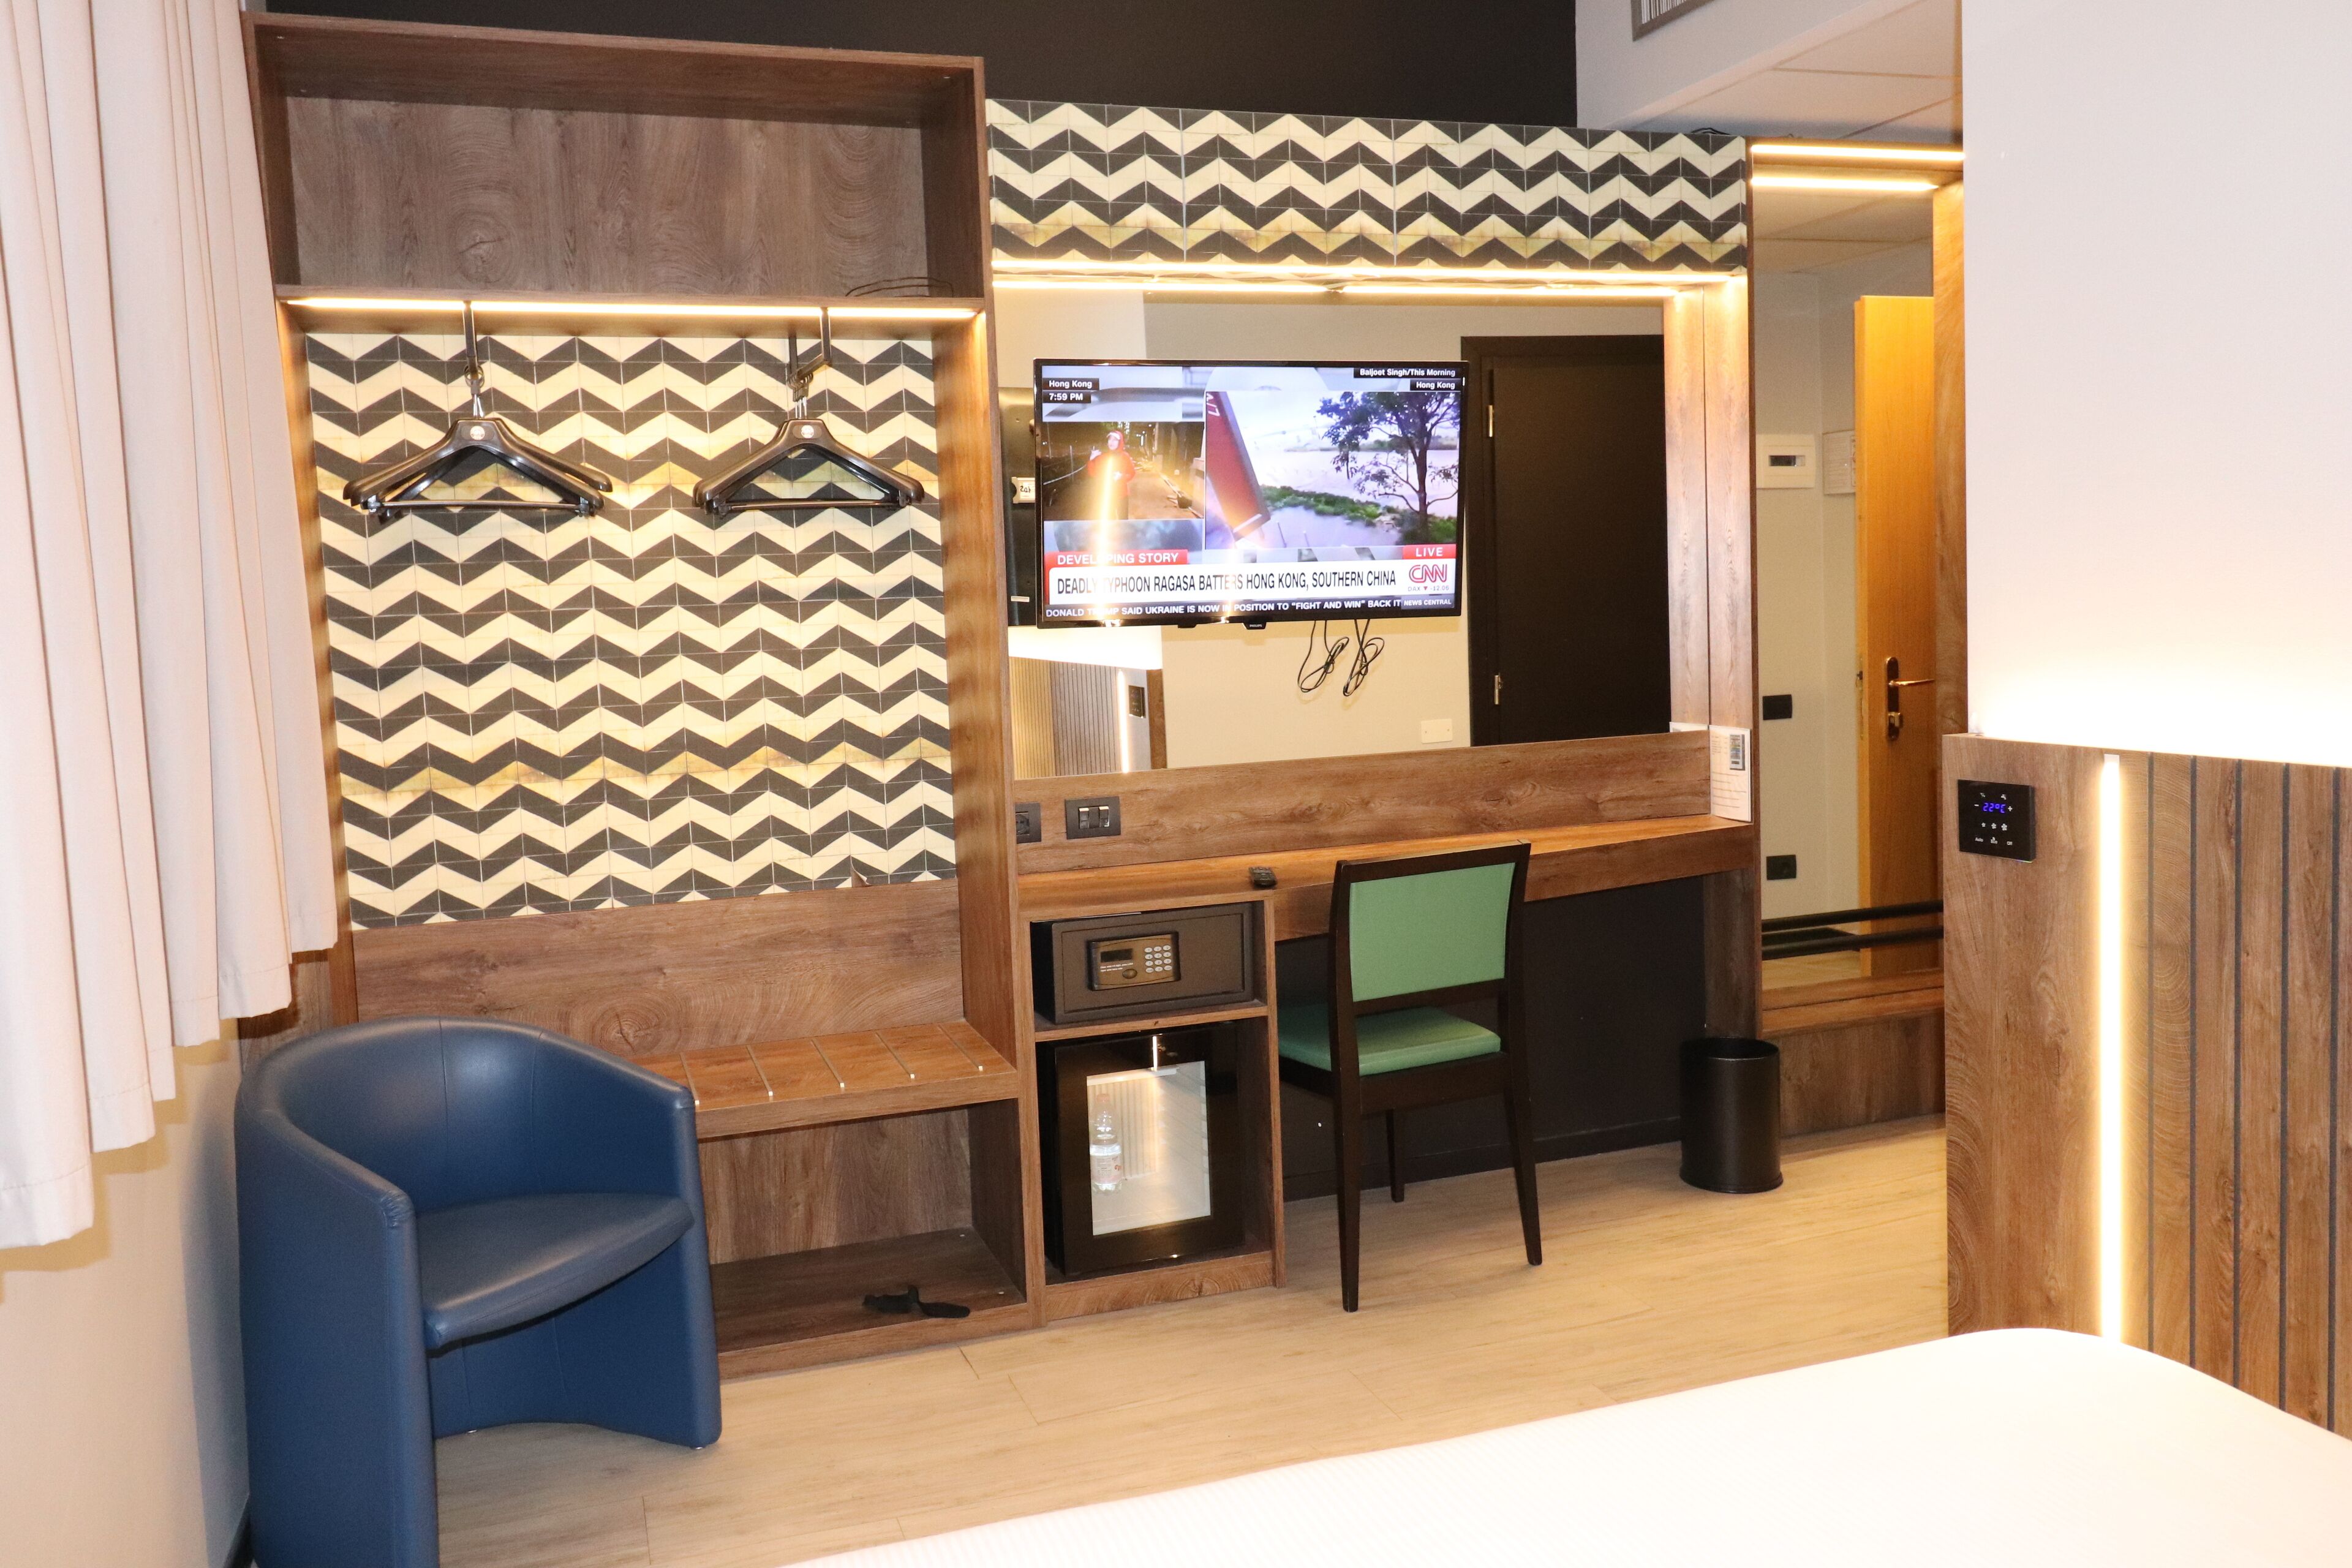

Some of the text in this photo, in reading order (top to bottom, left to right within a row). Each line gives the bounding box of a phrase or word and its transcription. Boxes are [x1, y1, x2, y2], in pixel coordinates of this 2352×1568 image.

[1387, 368, 1425, 377] Singh/This
[1049, 380, 1092, 389] Hong Kong
[1057, 552, 1179, 565] DEVELPING STORY
[1415, 547, 1443, 557] LIVE
[1409, 564, 1447, 583] CNN
[1057, 570, 1396, 594] DEADLY TYPHOON RAGASA BATTERS HONG KONG, SOUTHERN CHINA
[1046, 608, 1084, 617] DONALD
[1087, 607, 1119, 616] TMP
[1121, 606, 1143, 615] SAID
[1145, 605, 1185, 614] UKRAINE
[1234, 603, 1275, 611] POSITION
[1291, 601, 1321, 610] "FIGHT
